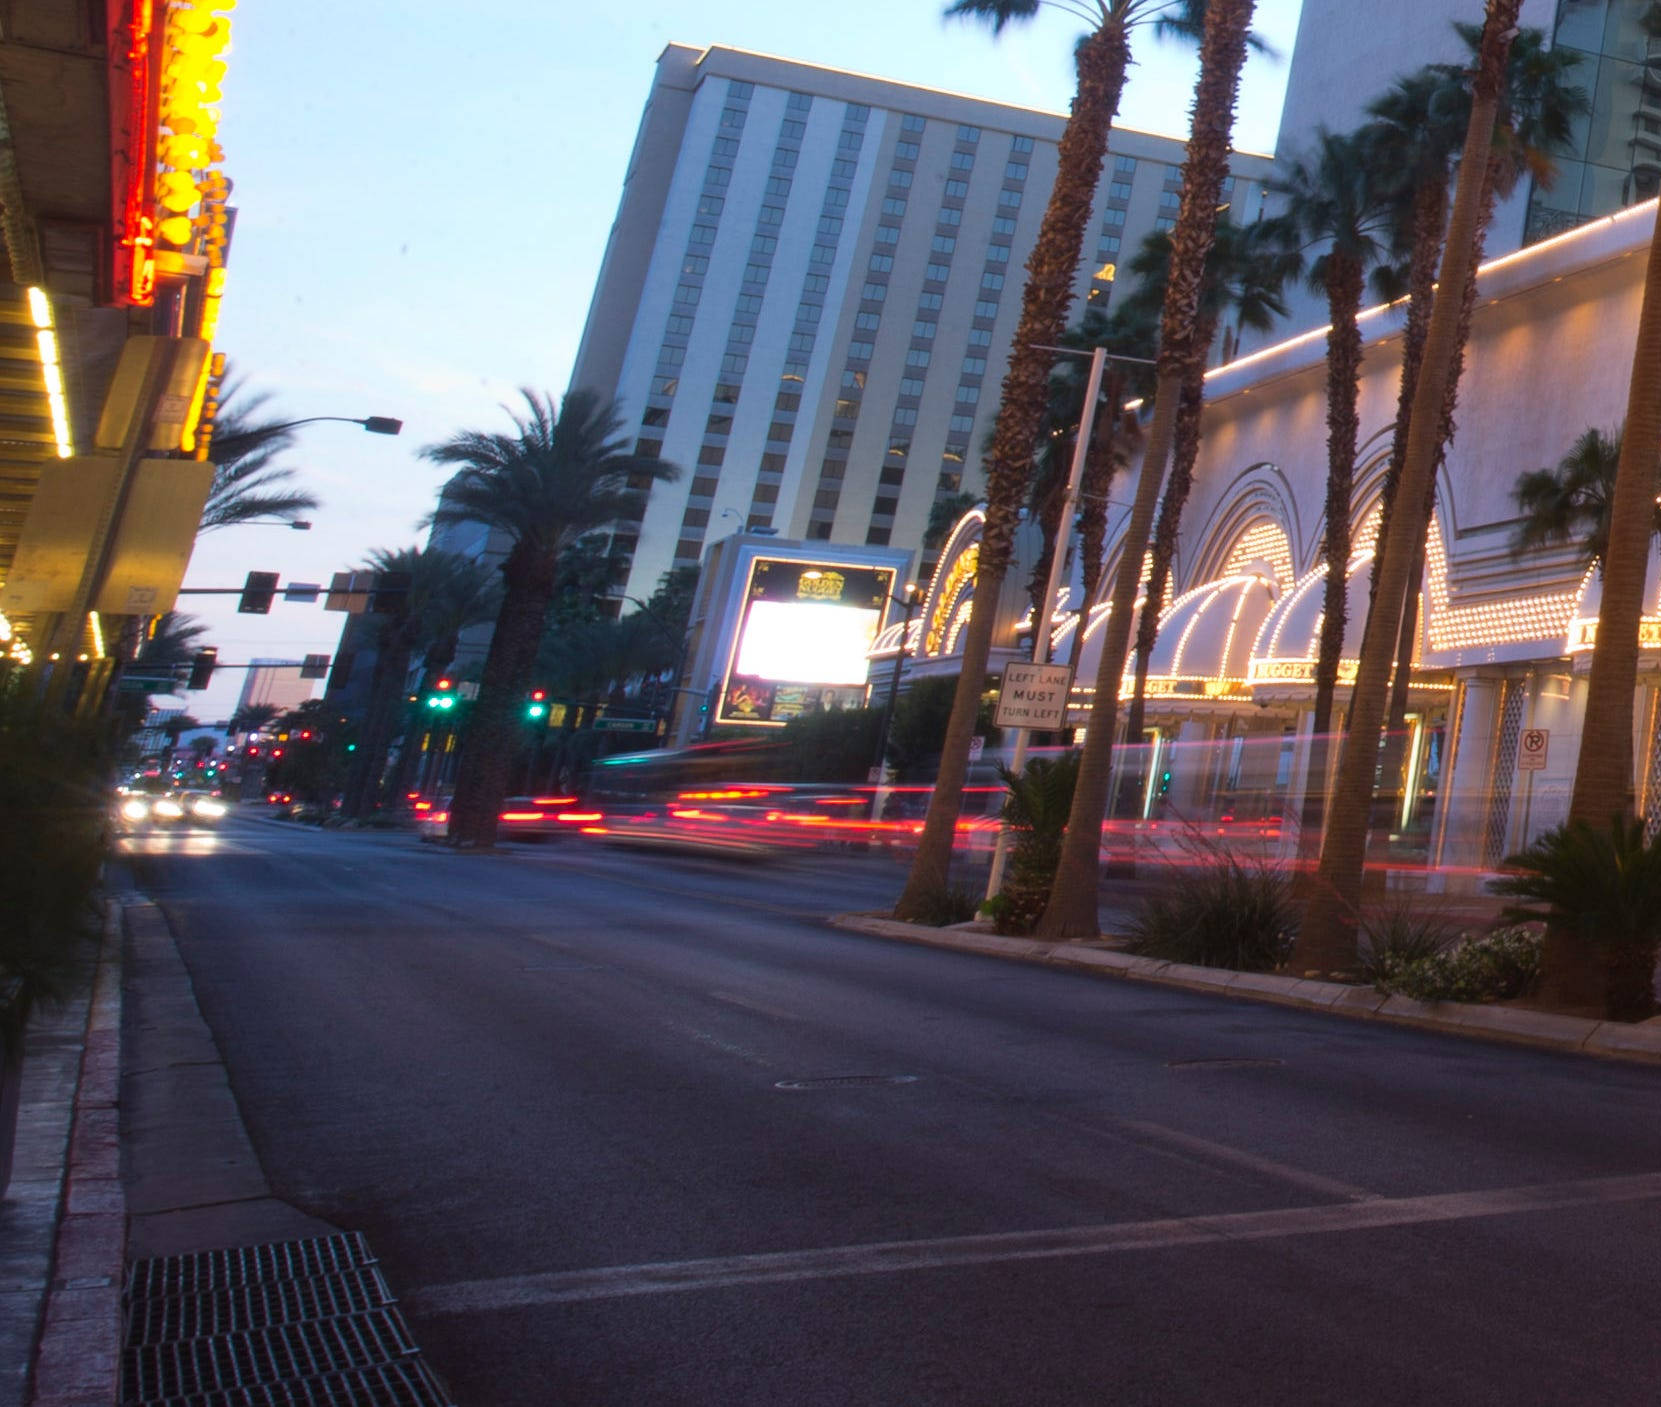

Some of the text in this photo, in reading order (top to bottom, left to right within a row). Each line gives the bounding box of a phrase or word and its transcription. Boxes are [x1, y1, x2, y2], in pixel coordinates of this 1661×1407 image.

[1008, 673, 1066, 685] LEFT LANE
[1013, 690, 1056, 702] MUST
[1003, 707, 1060, 719] TURN LEFT
